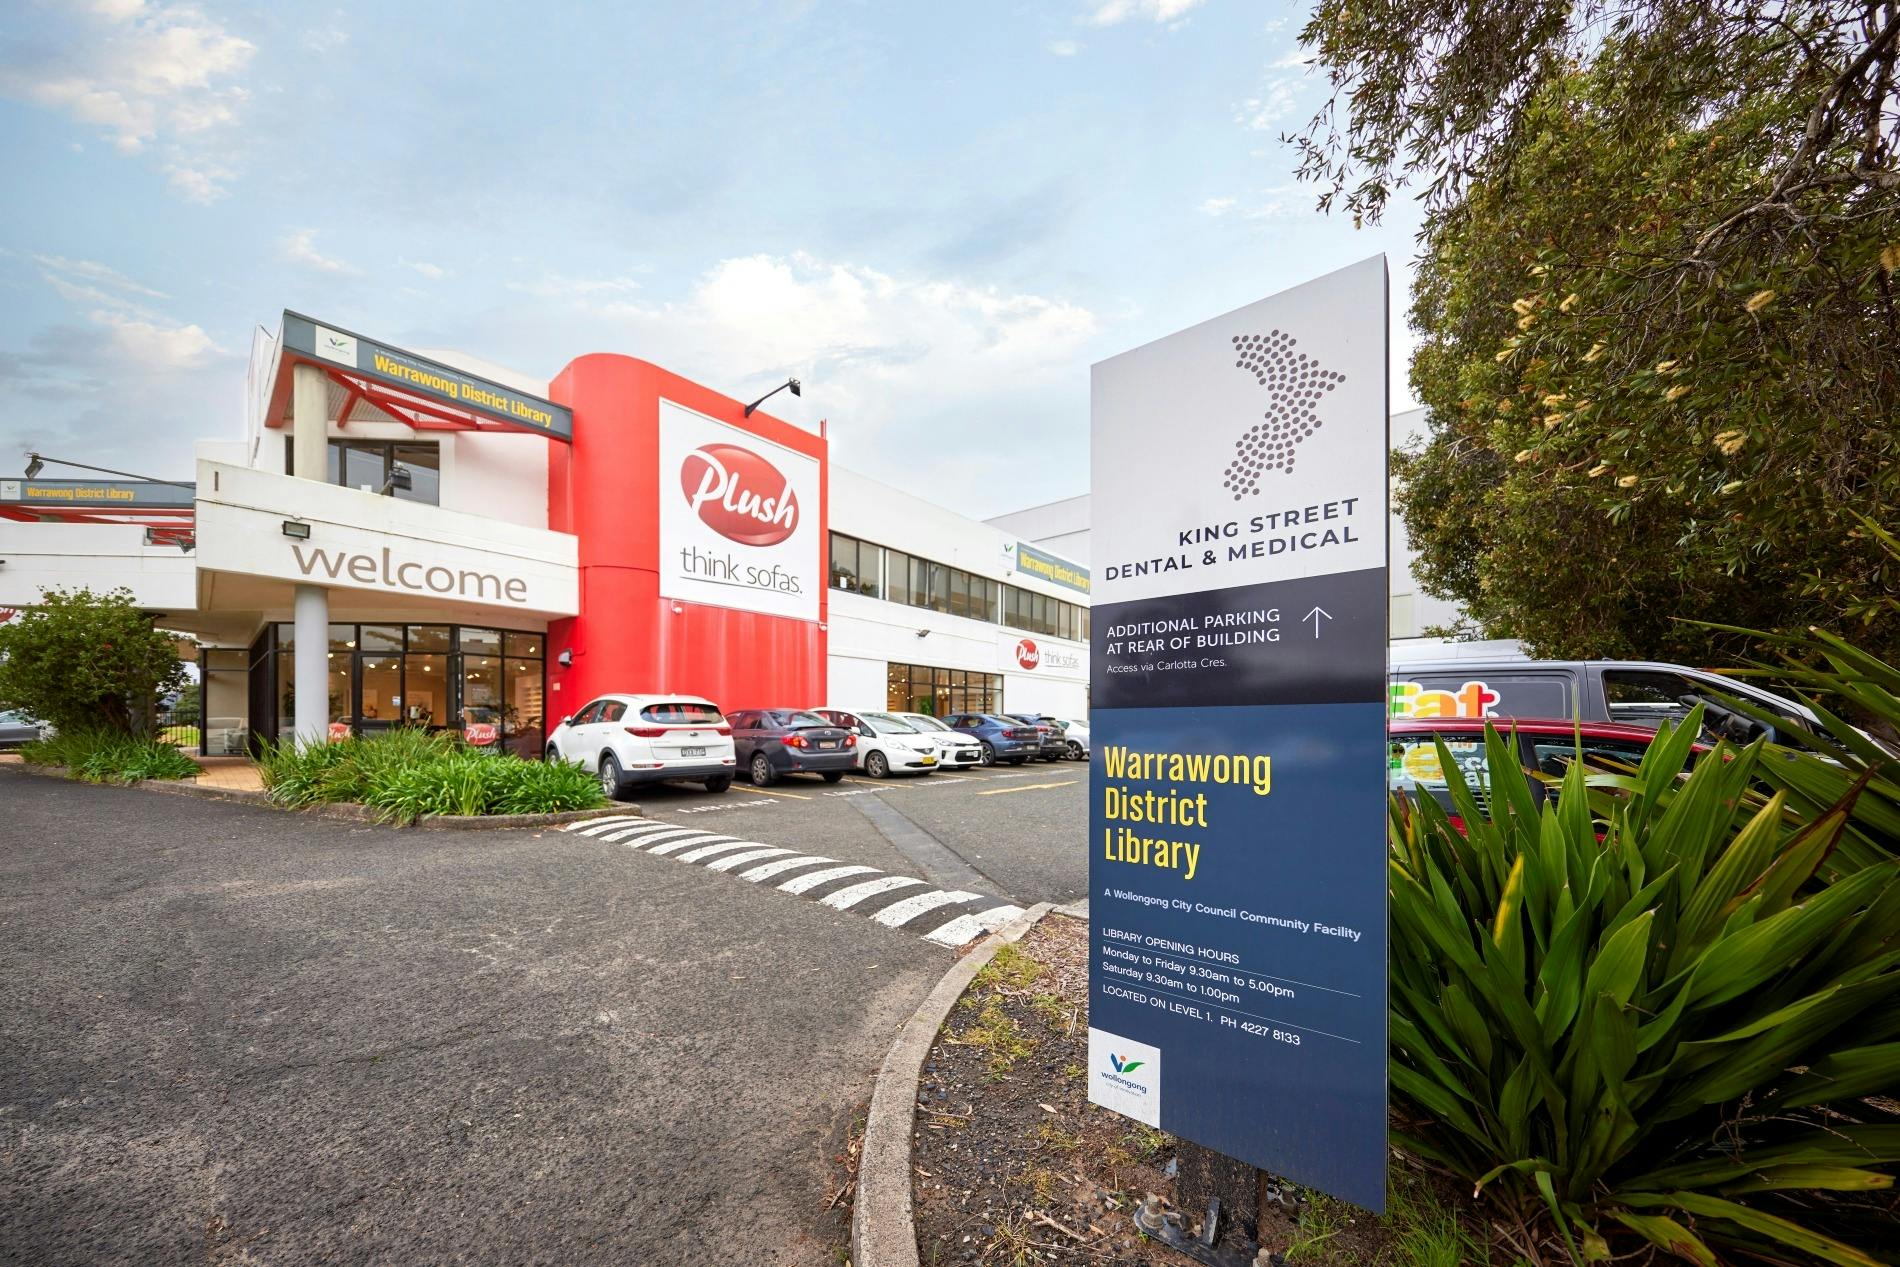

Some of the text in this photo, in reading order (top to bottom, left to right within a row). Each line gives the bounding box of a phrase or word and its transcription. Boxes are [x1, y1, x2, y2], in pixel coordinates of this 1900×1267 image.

[374, 354, 458, 398] Warrawong
[461, 383, 508, 411] District
[511, 401, 552, 428] Library
[27, 487, 135, 501] Warrawong District Library
[684, 449, 795, 529] Plush
[1179, 497, 1359, 546] KING STREET
[291, 544, 527, 602] welcome
[680, 546, 803, 594] think sofas.
[1105, 526, 1359, 581] DENTAL & MEDICAL
[1106, 608, 1280, 638] ADDITIONAL PARKING
[1106, 629, 1280, 655] AT REAR OF BUILDING
[1017, 643, 1039, 663] Plush
[1106, 657, 1228, 674] Access via Carlotta Cres.
[466, 727, 496, 742] Plush
[1104, 746, 1271, 796] Warrawong
[1105, 786, 1208, 828] District
[1105, 828, 1200, 880] Library
[1104, 888, 1362, 942] A Wollongong City Council Community Facility
[1103, 927, 1240, 965] LIBRARY OPENING HOURS
[1102, 961, 1240, 1004] Saturday 9.30am to 1.00pm
[1103, 945, 1295, 999] Monday to Friday 9.30am to 5.00pm
[1103, 984, 1301, 1046] LOCATED ON LEVEL 1. PH 4227 8133
[1101, 1071, 1147, 1094] wollongong
